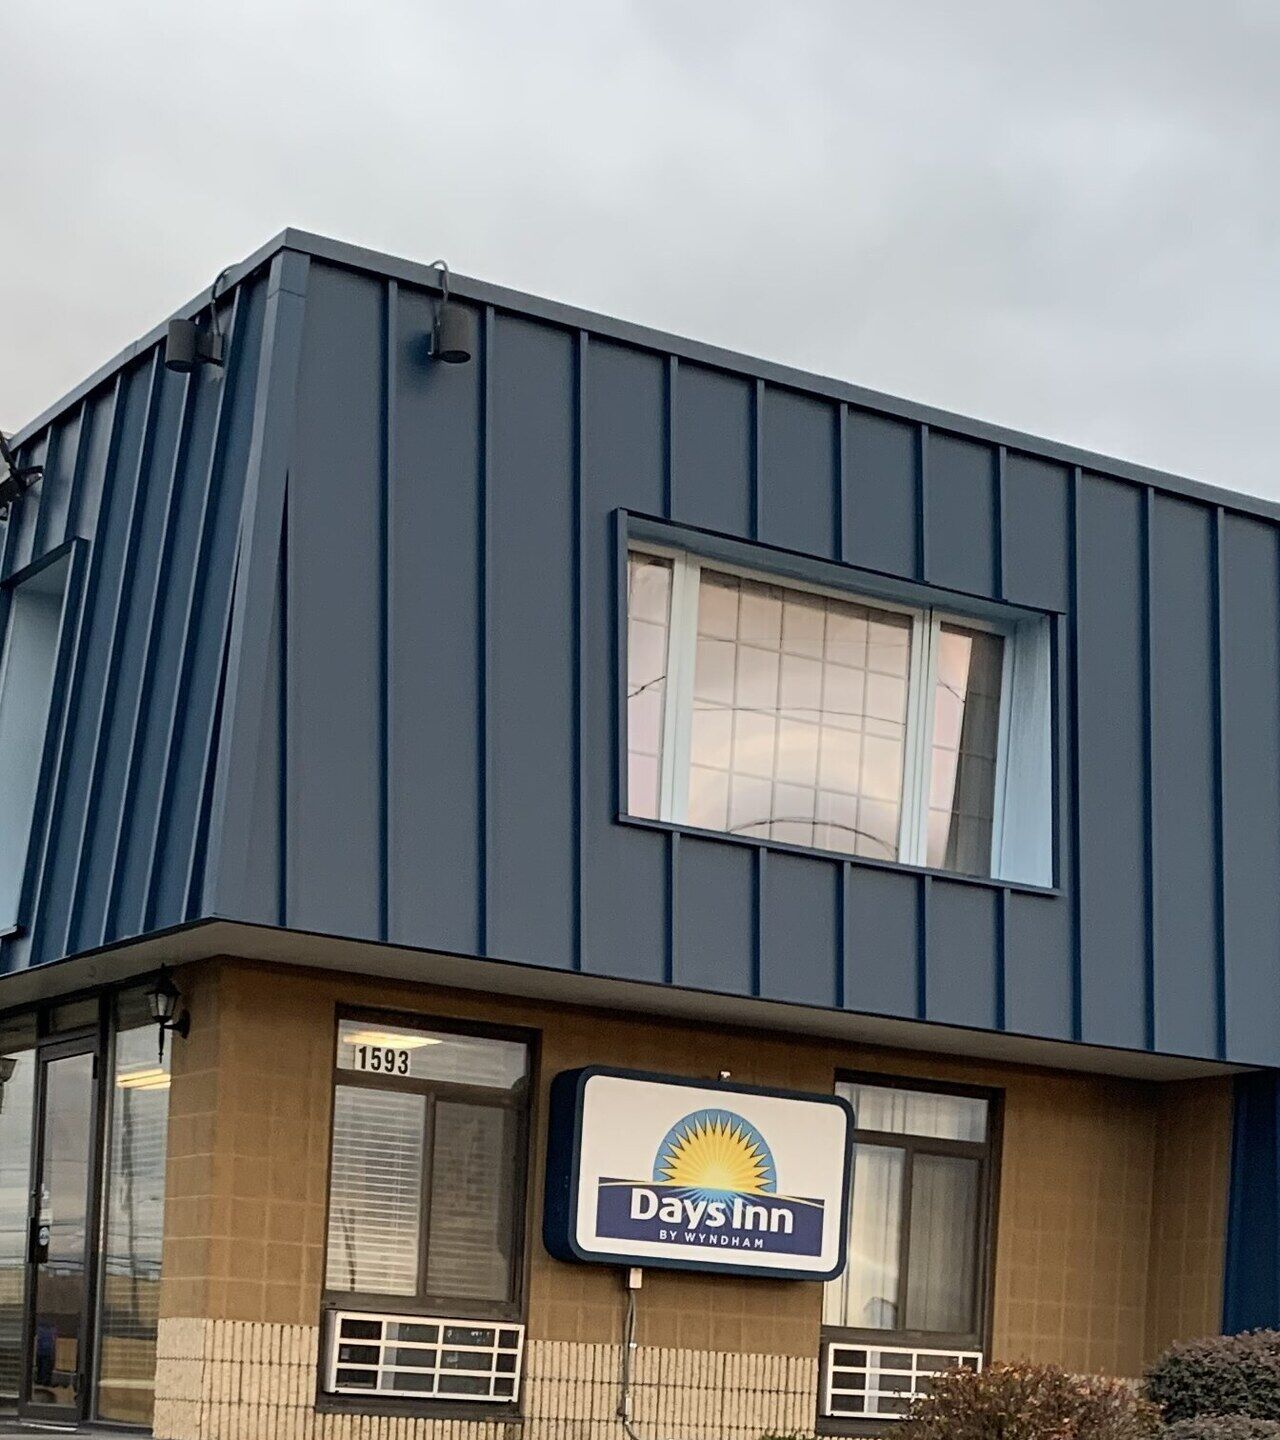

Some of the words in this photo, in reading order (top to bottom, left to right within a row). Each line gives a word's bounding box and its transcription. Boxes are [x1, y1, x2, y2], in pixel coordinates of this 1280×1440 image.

[359, 1046, 409, 1075] 1593
[630, 1187, 726, 1230] Days
[732, 1197, 794, 1234] Inn
[659, 1229, 678, 1241] BY
[684, 1231, 764, 1249] WYNDHAM
